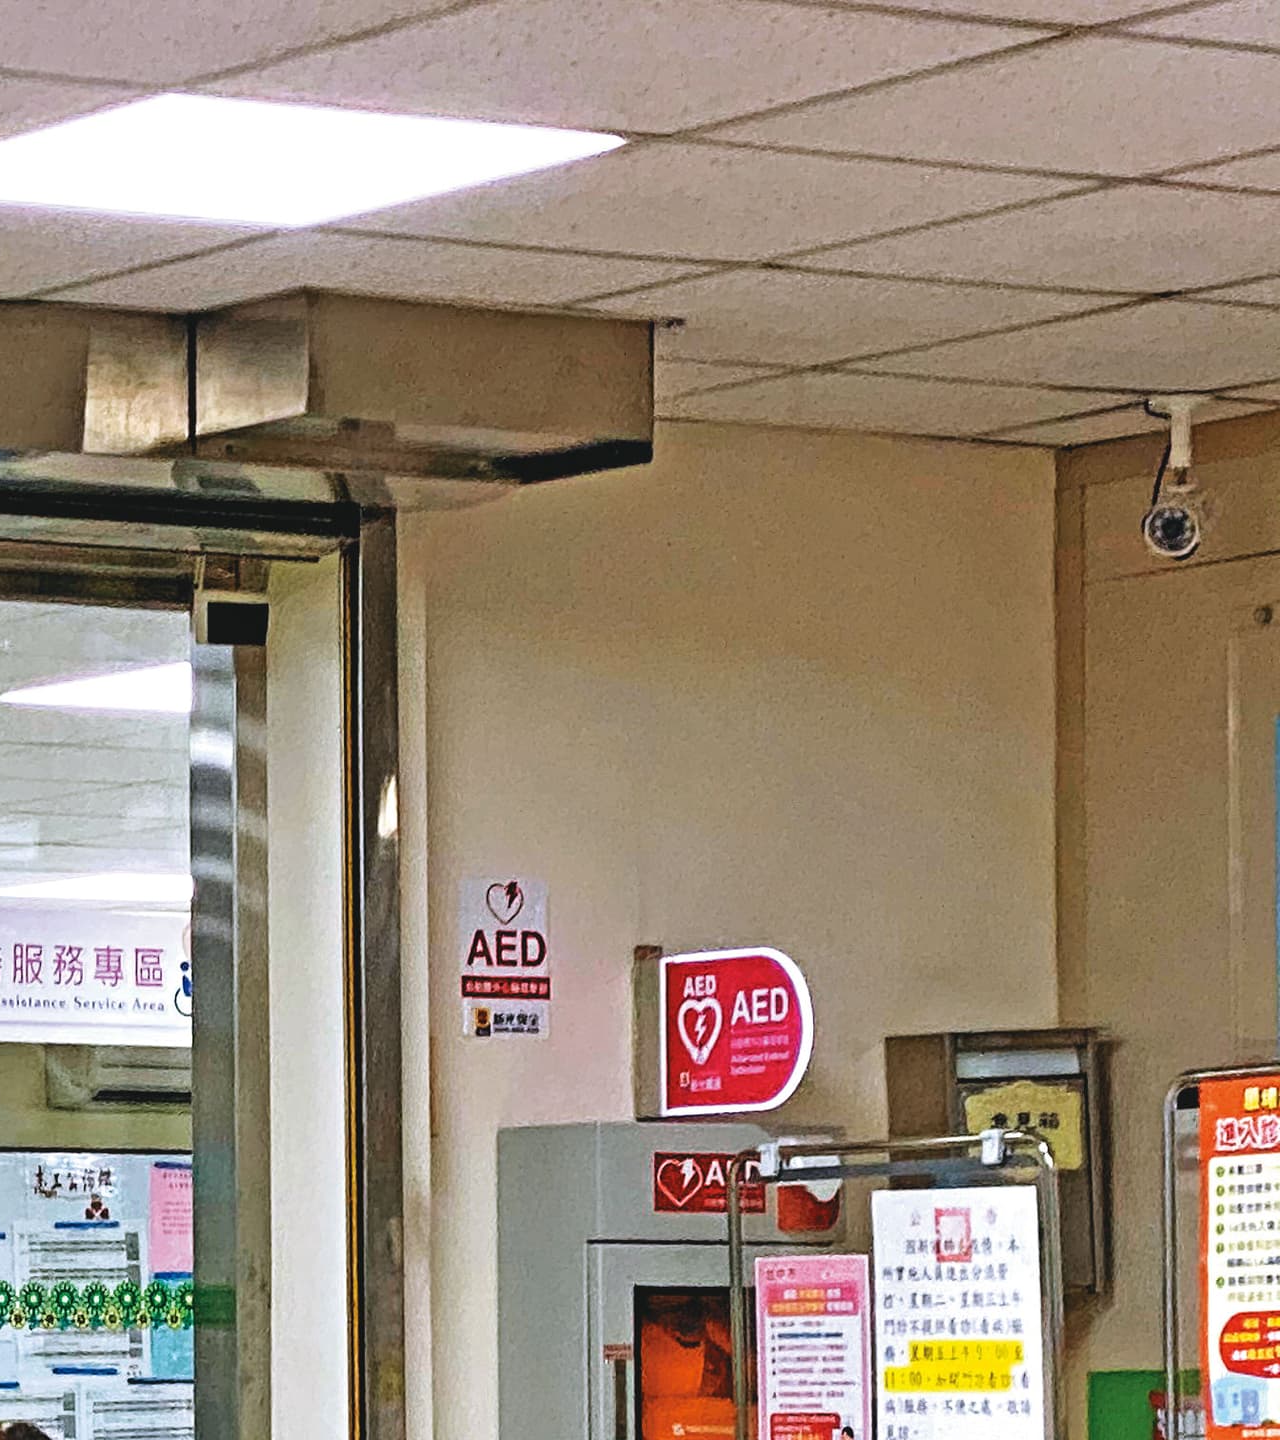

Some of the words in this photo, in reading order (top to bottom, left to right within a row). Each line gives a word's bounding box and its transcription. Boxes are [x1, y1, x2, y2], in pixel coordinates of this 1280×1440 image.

[467, 930, 547, 967] AED
[683, 974, 717, 997] AED
[74, 996, 125, 1010] Service
[133, 998, 164, 1012] Area
[731, 987, 789, 1025] AED
